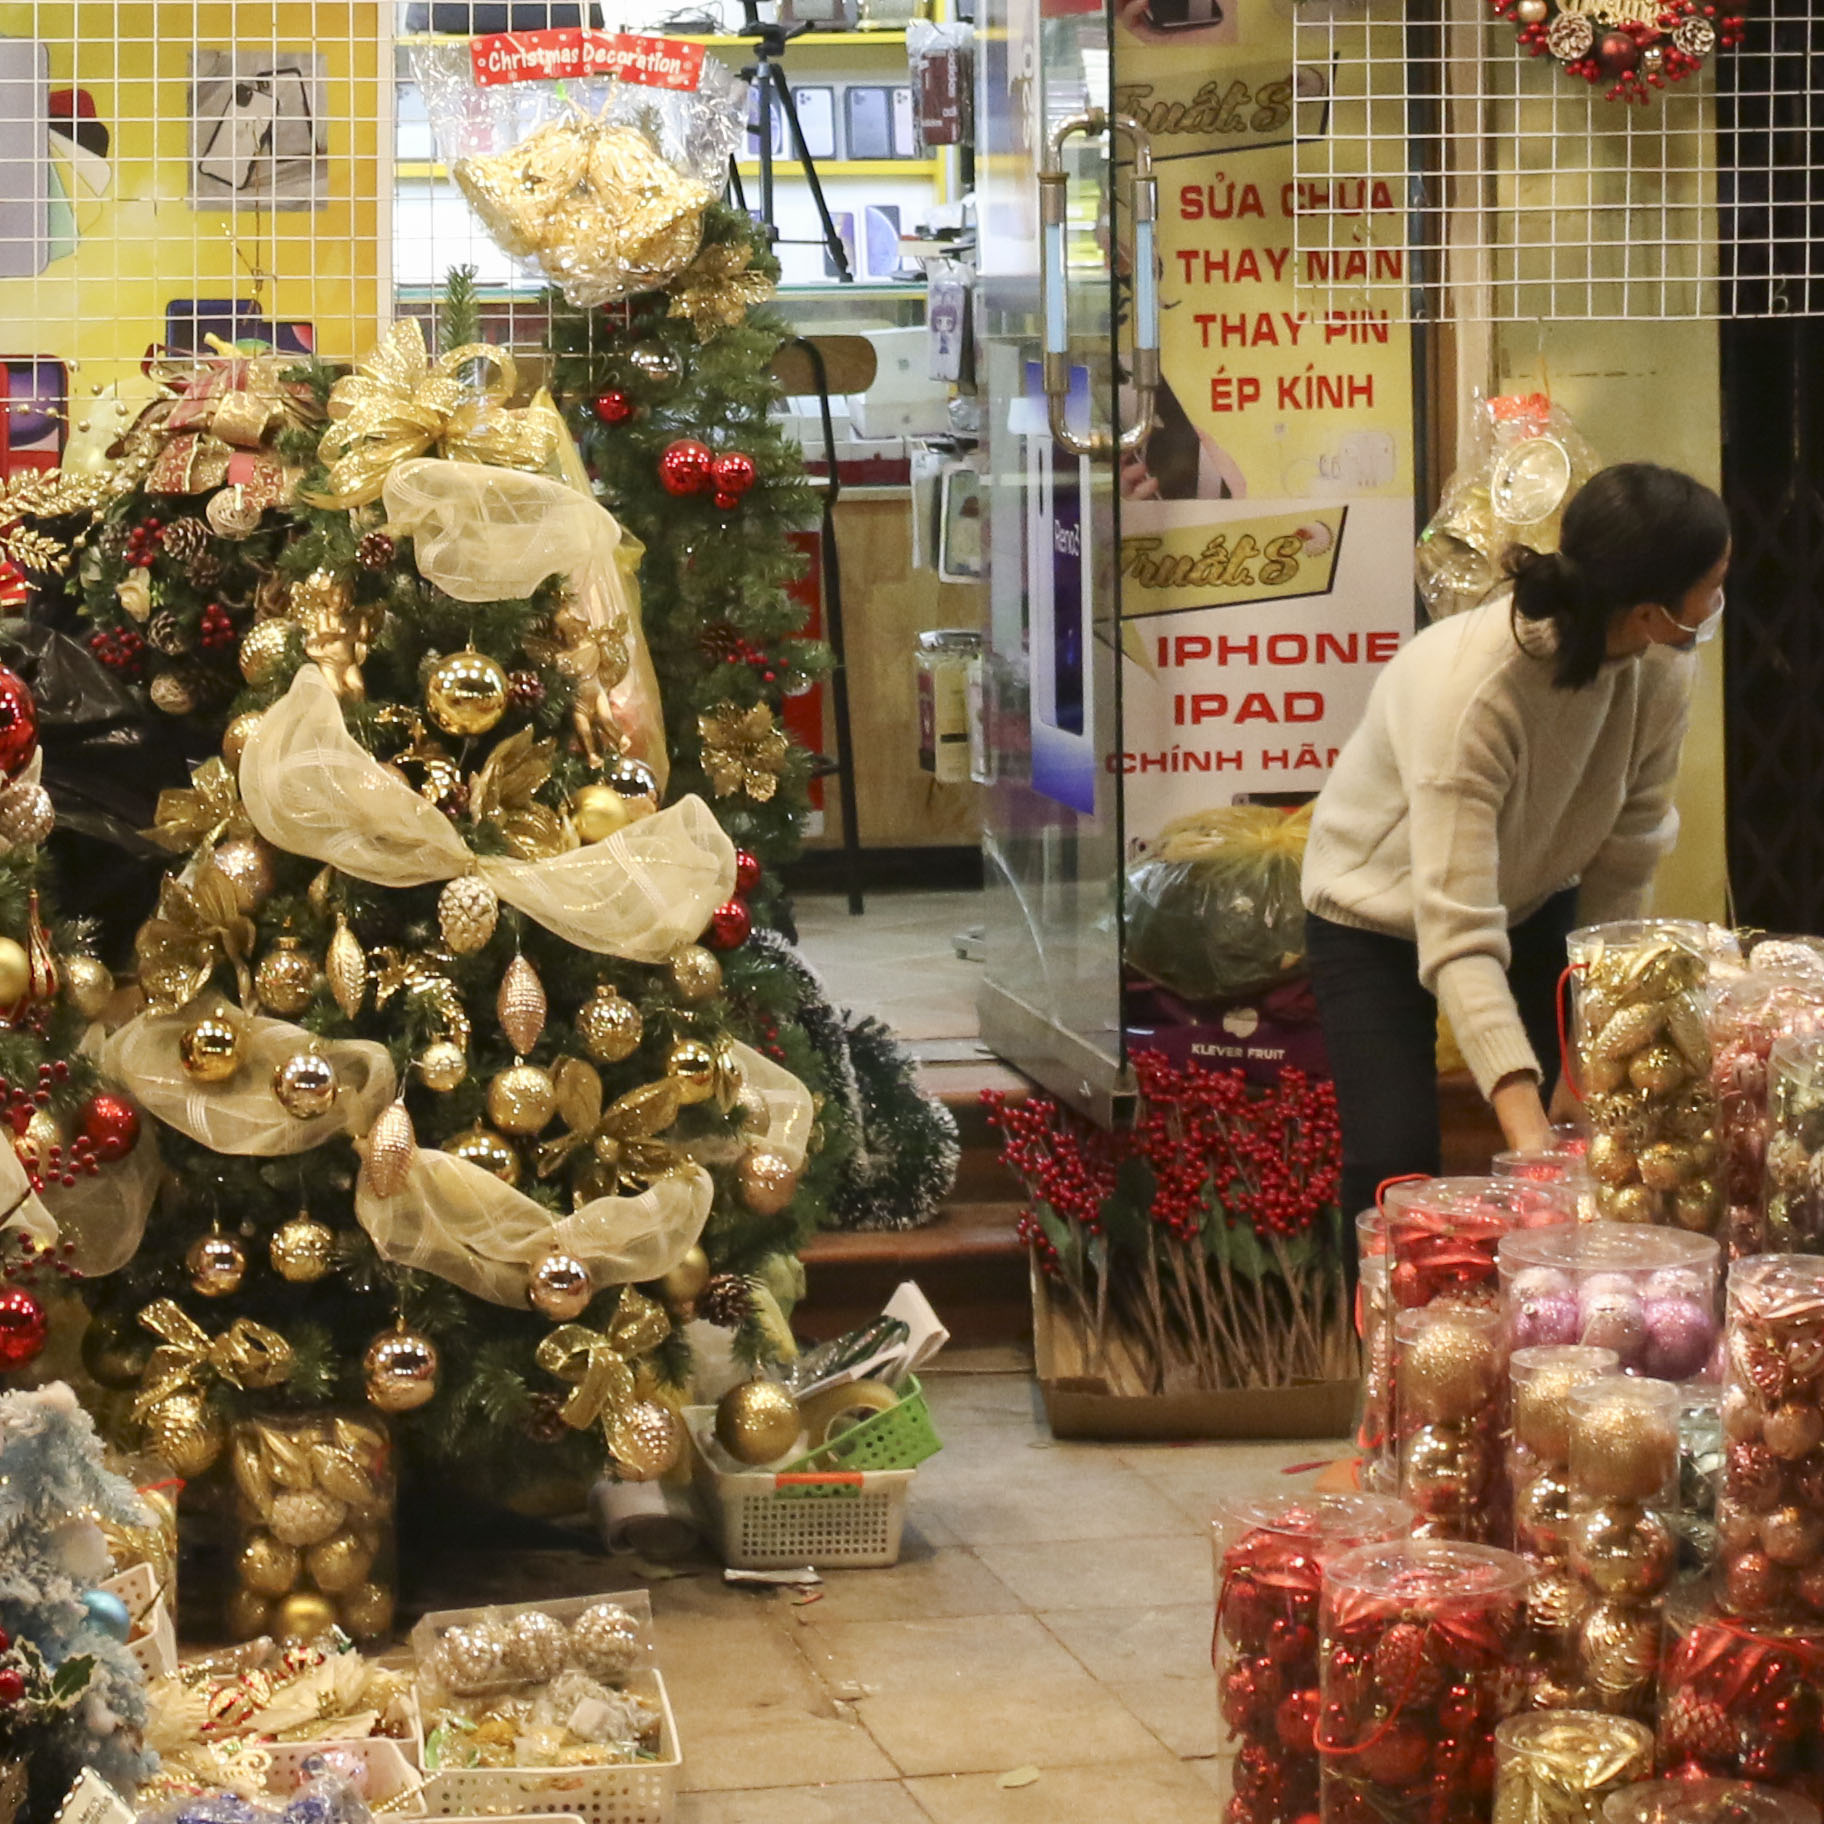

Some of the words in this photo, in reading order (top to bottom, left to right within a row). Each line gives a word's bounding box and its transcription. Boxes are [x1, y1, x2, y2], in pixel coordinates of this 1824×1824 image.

[487, 45, 580, 72] Christmas
[582, 45, 682, 76] Decoration
[1179, 172, 1266, 220] SỬA
[1176, 248, 1292, 285] THAY
[1307, 233, 1402, 281] MÀN
[1194, 311, 1306, 348] THAY
[1325, 309, 1390, 345] PIN
[1211, 364, 1261, 413] ÉP
[1278, 362, 1374, 411] KÍNH
[1157, 631, 1401, 668] IPHONE
[1175, 691, 1324, 727] IPAD
[1105, 744, 1244, 776] CHÍNH
[1190, 1042, 1244, 1059] KLEVER
[1247, 1047, 1286, 1061] FRUIT
